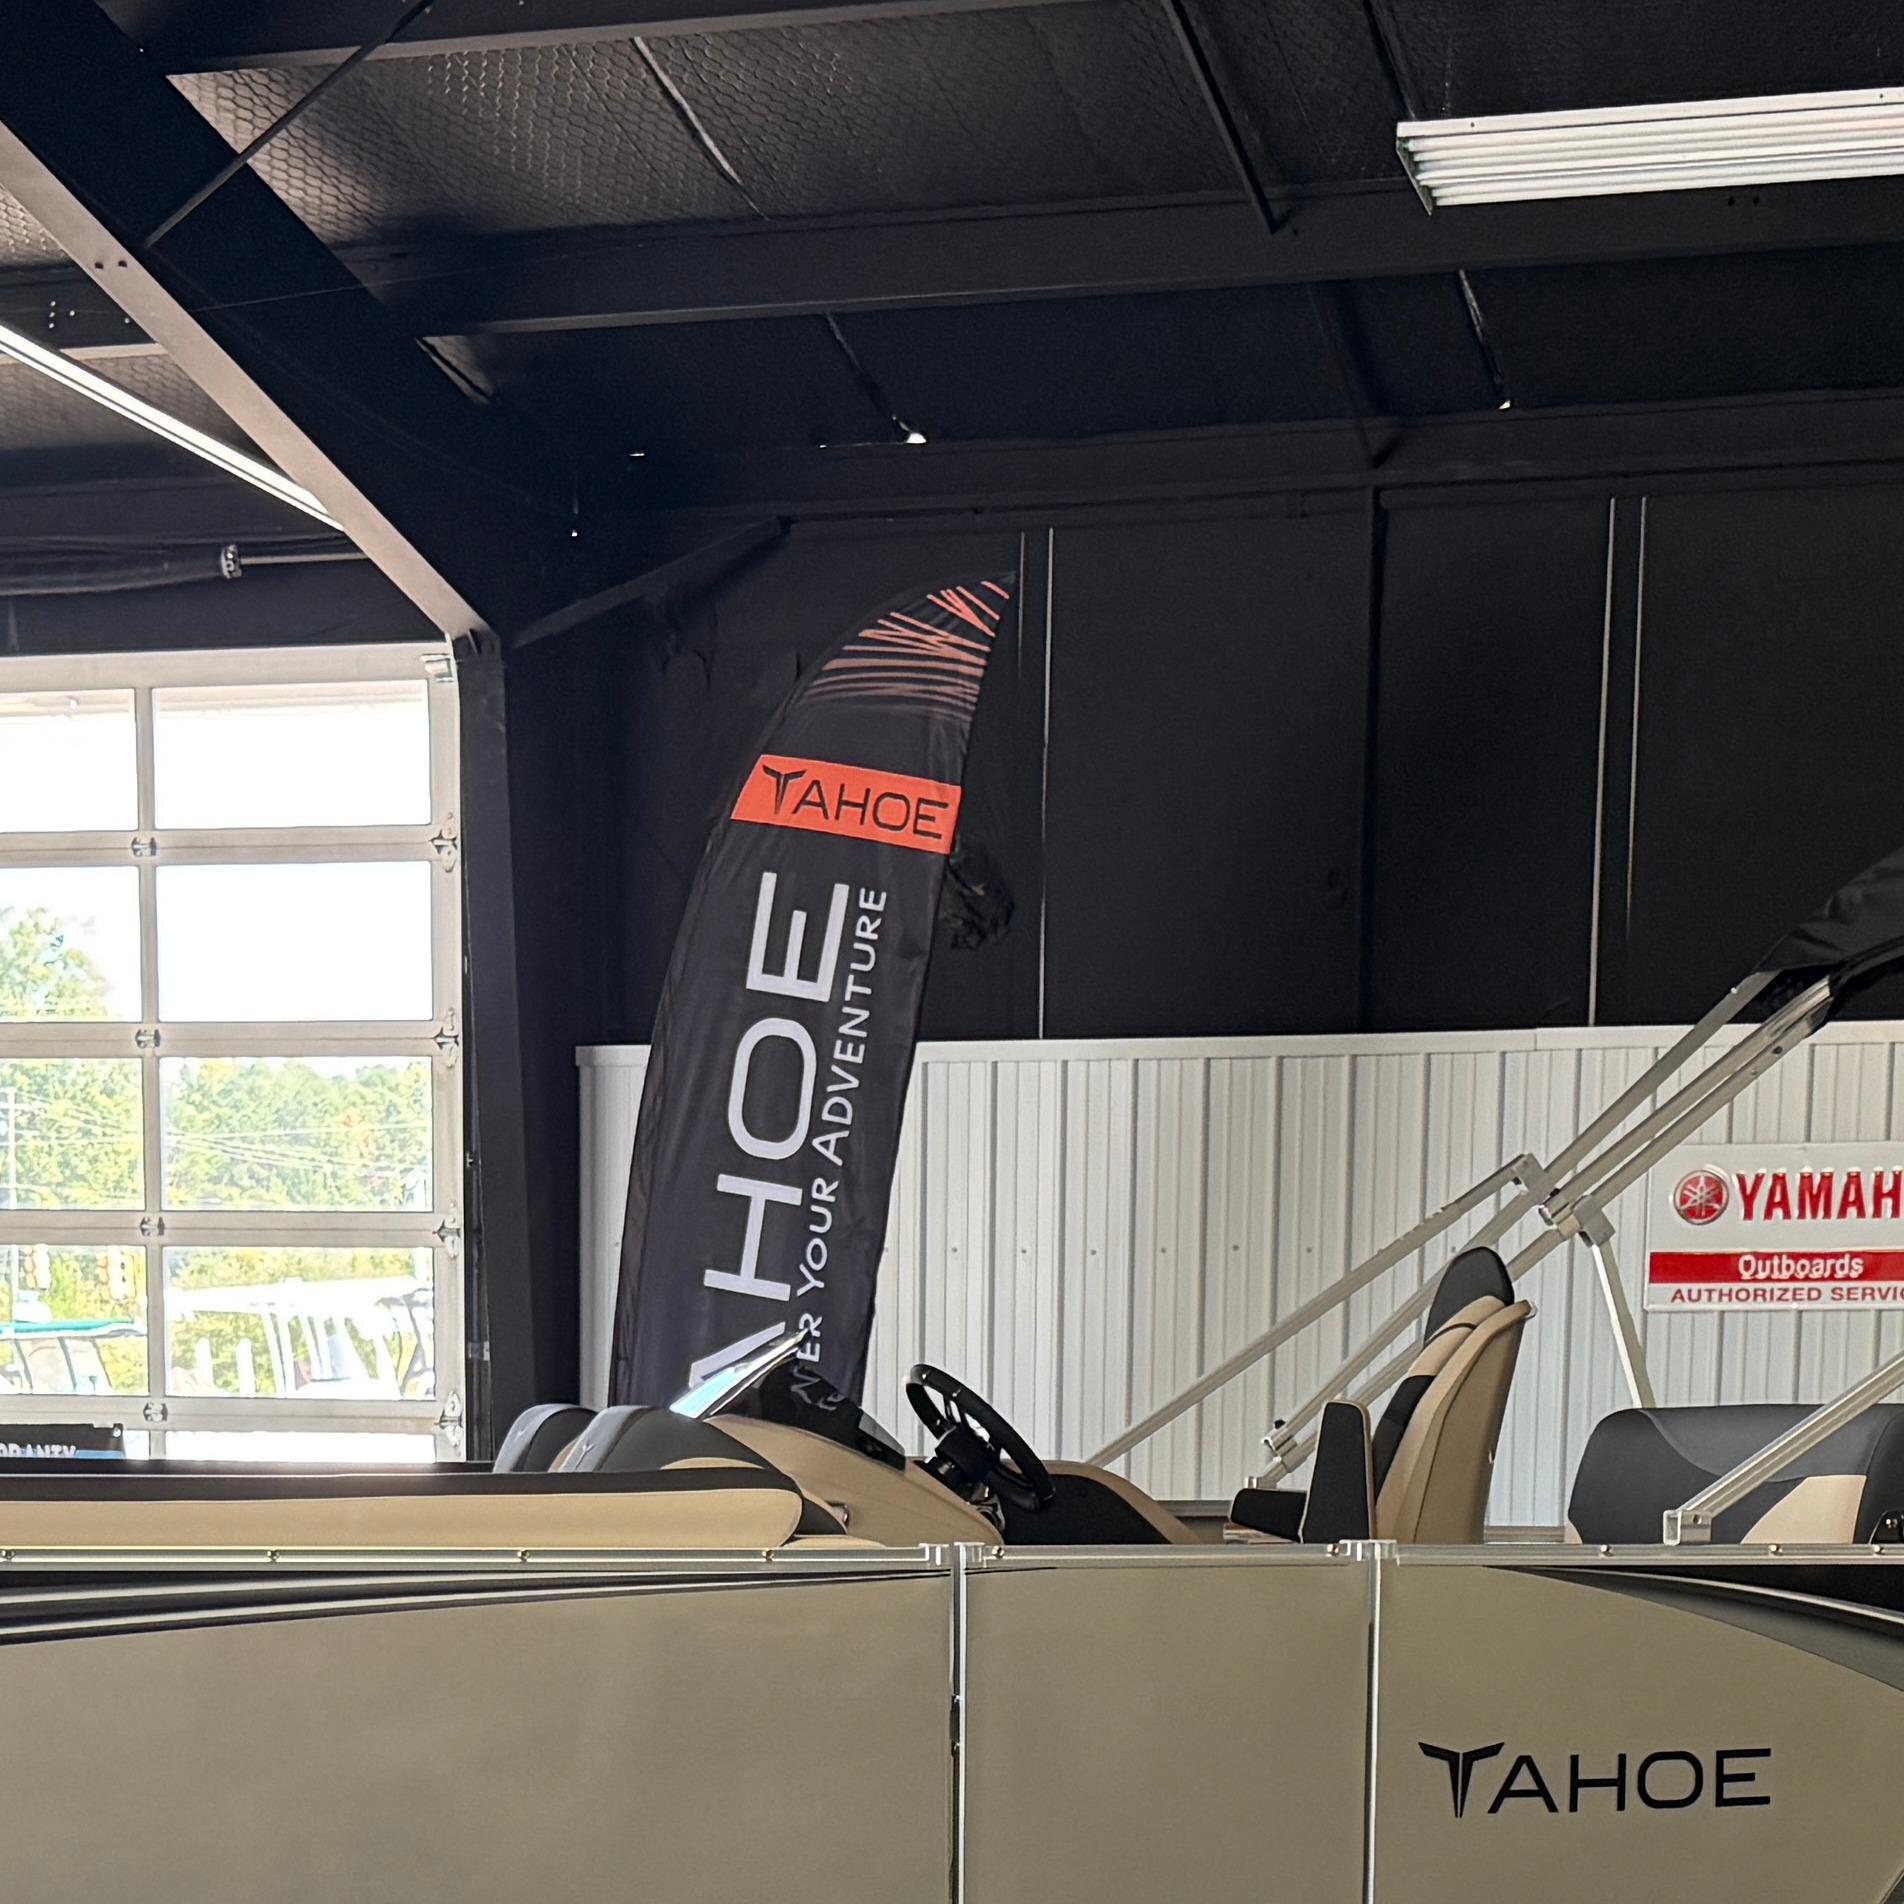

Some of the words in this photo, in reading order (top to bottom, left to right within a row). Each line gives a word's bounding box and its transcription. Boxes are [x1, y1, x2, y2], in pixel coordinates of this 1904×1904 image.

[762, 764, 949, 840] TAHOE
[812, 887, 887, 1166] ADVENTURE
[797, 1177, 839, 1297] YOUR
[1738, 1254, 1864, 1279] Outboards
[1670, 1286, 1822, 1303] AUTHORIZED
[1417, 1741, 1772, 1819] TAHOE
